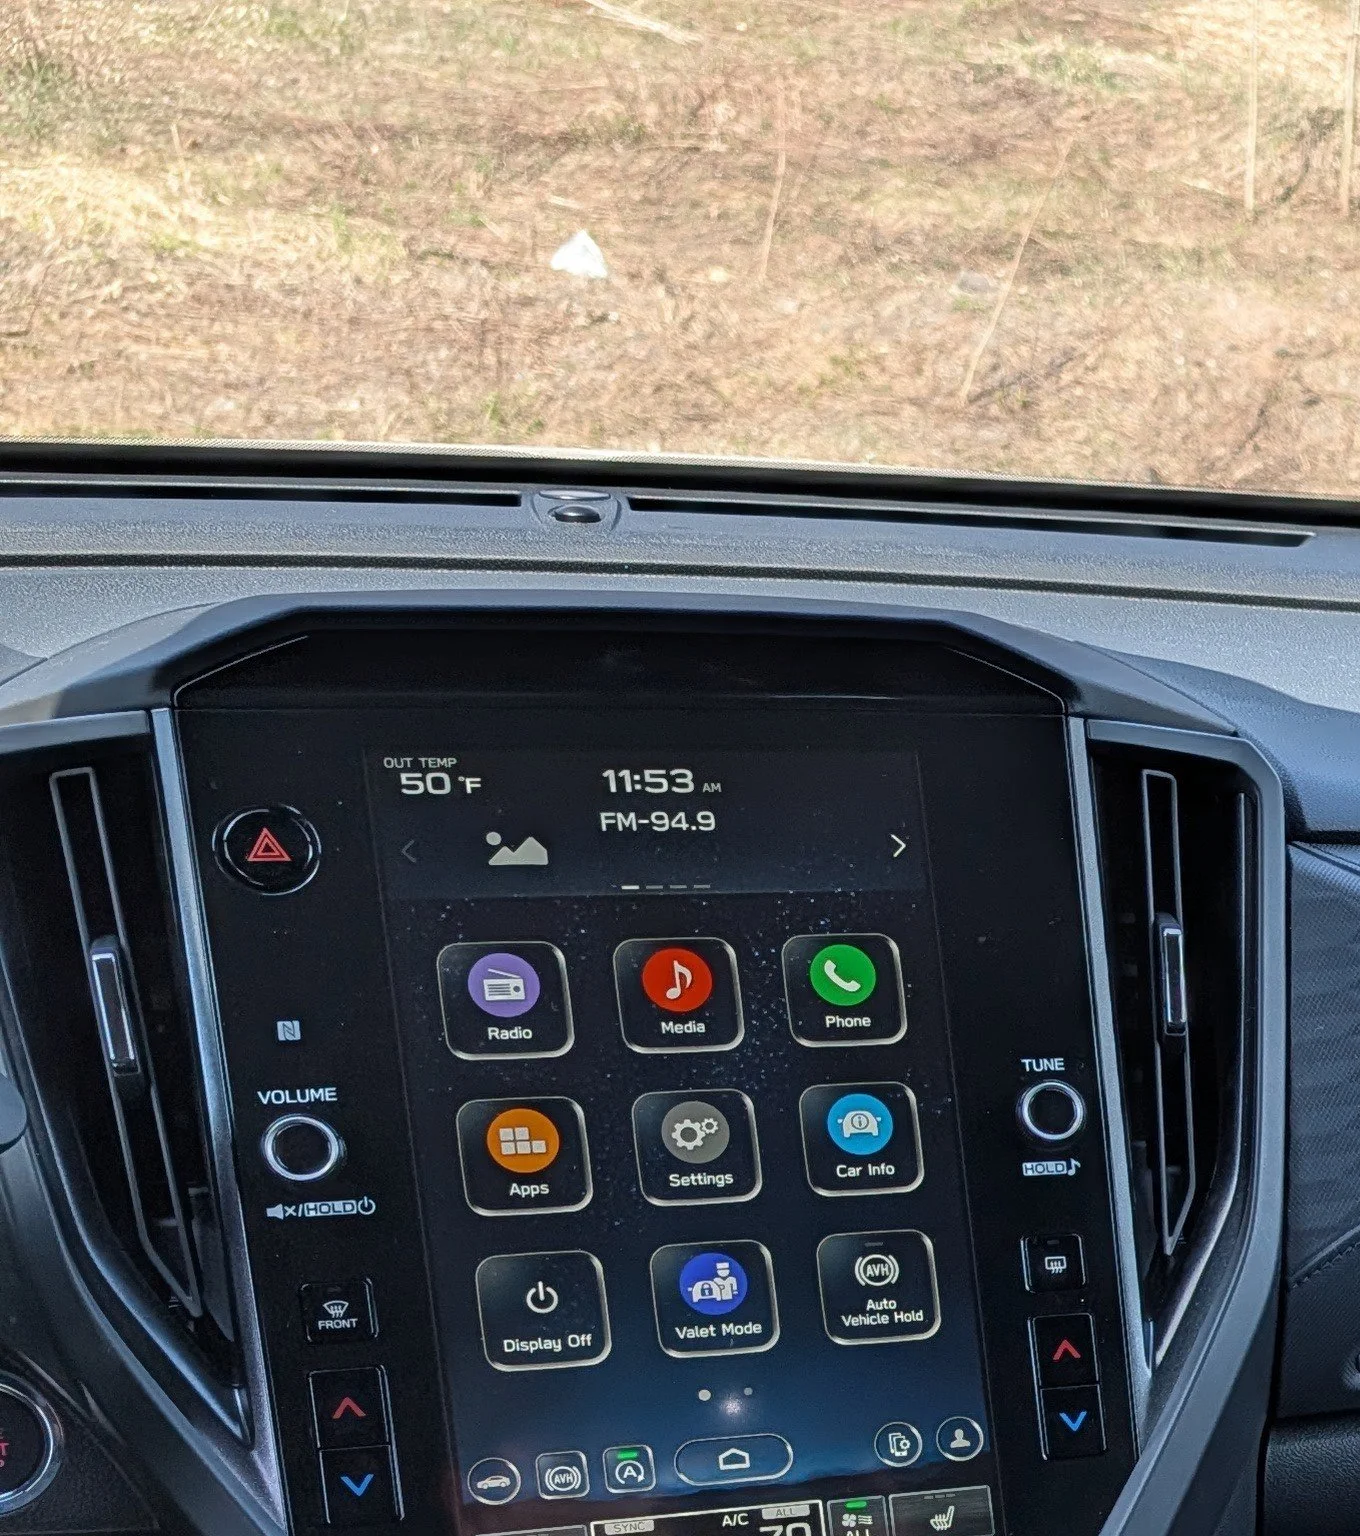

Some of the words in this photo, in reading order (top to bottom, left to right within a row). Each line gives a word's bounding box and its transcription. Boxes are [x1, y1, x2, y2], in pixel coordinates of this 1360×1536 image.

[384, 757, 412, 769] OUT
[419, 757, 457, 769] TEMP
[400, 772, 451, 795] 50
[602, 768, 695, 794] 11:53
[702, 782, 722, 794] AM
[599, 810, 717, 832] FM-94.9
[661, 1020, 706, 1035] Media
[825, 1014, 872, 1029] Phone
[487, 1026, 533, 1041] Radio
[1021, 1058, 1065, 1072] TUNE
[257, 1087, 338, 1105] VOLUME
[836, 1164, 861, 1178] Car
[868, 1162, 895, 1177] Info
[1024, 1161, 1066, 1175] HOLD
[669, 1171, 734, 1189] Settings
[509, 1181, 550, 1199] Apps
[864, 1263, 889, 1277] AVH
[866, 1299, 897, 1311] Auto
[318, 1317, 358, 1330] FRONT
[841, 1311, 889, 1327] Vehicle
[894, 1309, 924, 1323] Hold
[675, 1324, 716, 1341] Valet
[722, 1321, 763, 1336] Mode
[503, 1335, 562, 1355] Display
[567, 1333, 593, 1350] Off
[554, 1472, 573, 1485] AVH
[775, 1507, 797, 1517] ALL
[613, 1522, 646, 1533] SYNC
[721, 1513, 749, 1528] A/C
